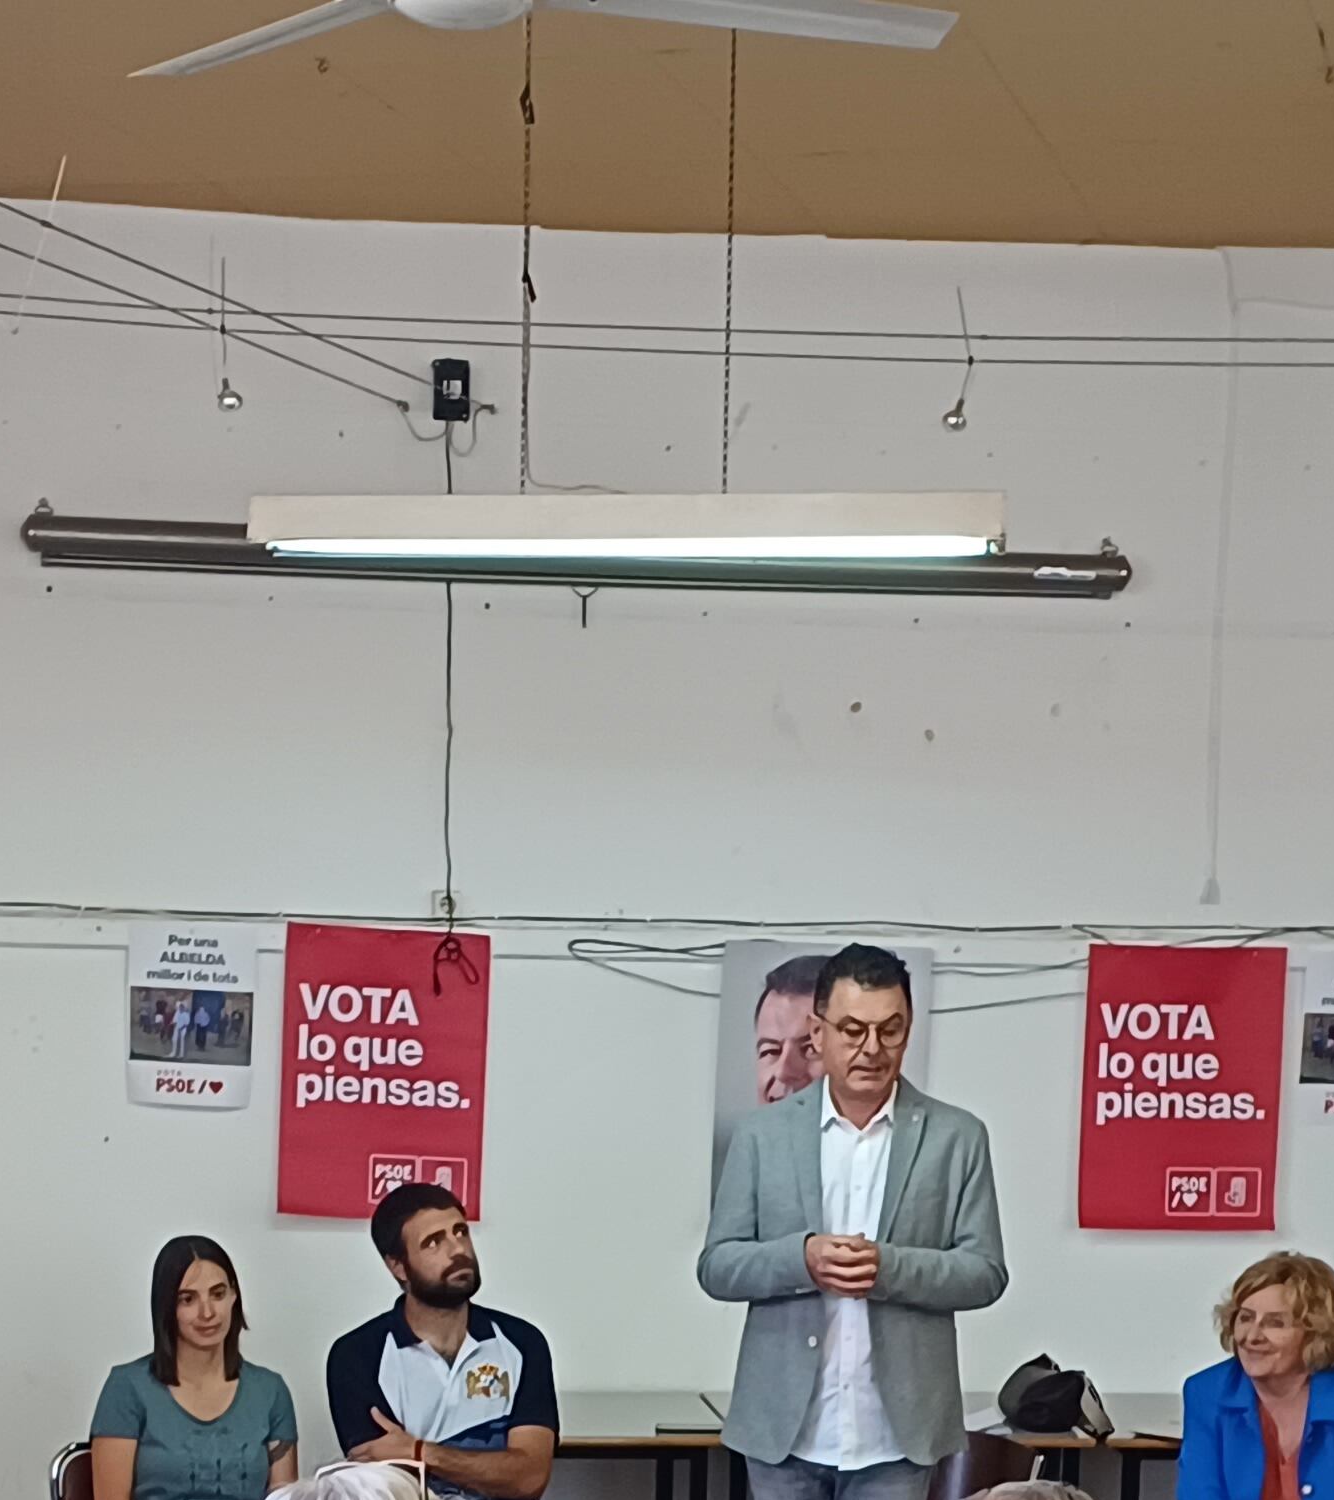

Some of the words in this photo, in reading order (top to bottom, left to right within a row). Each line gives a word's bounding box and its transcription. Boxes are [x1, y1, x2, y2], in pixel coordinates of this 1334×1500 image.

[160, 951, 226, 966] ALBELDA
[168, 934, 192, 946] Per
[299, 983, 419, 1026] VOTA
[1100, 1002, 1215, 1040] VOTA
[297, 1024, 336, 1062] lo
[344, 1035, 423, 1071] que
[1098, 1042, 1134, 1079] lo
[1141, 1052, 1220, 1087] que
[156, 1077, 195, 1094] PSOE
[296, 1065, 470, 1109] piensas.
[1096, 1082, 1265, 1126] piensas.
[374, 1164, 412, 1180] PSOE
[1171, 1176, 1208, 1192] PSOE
